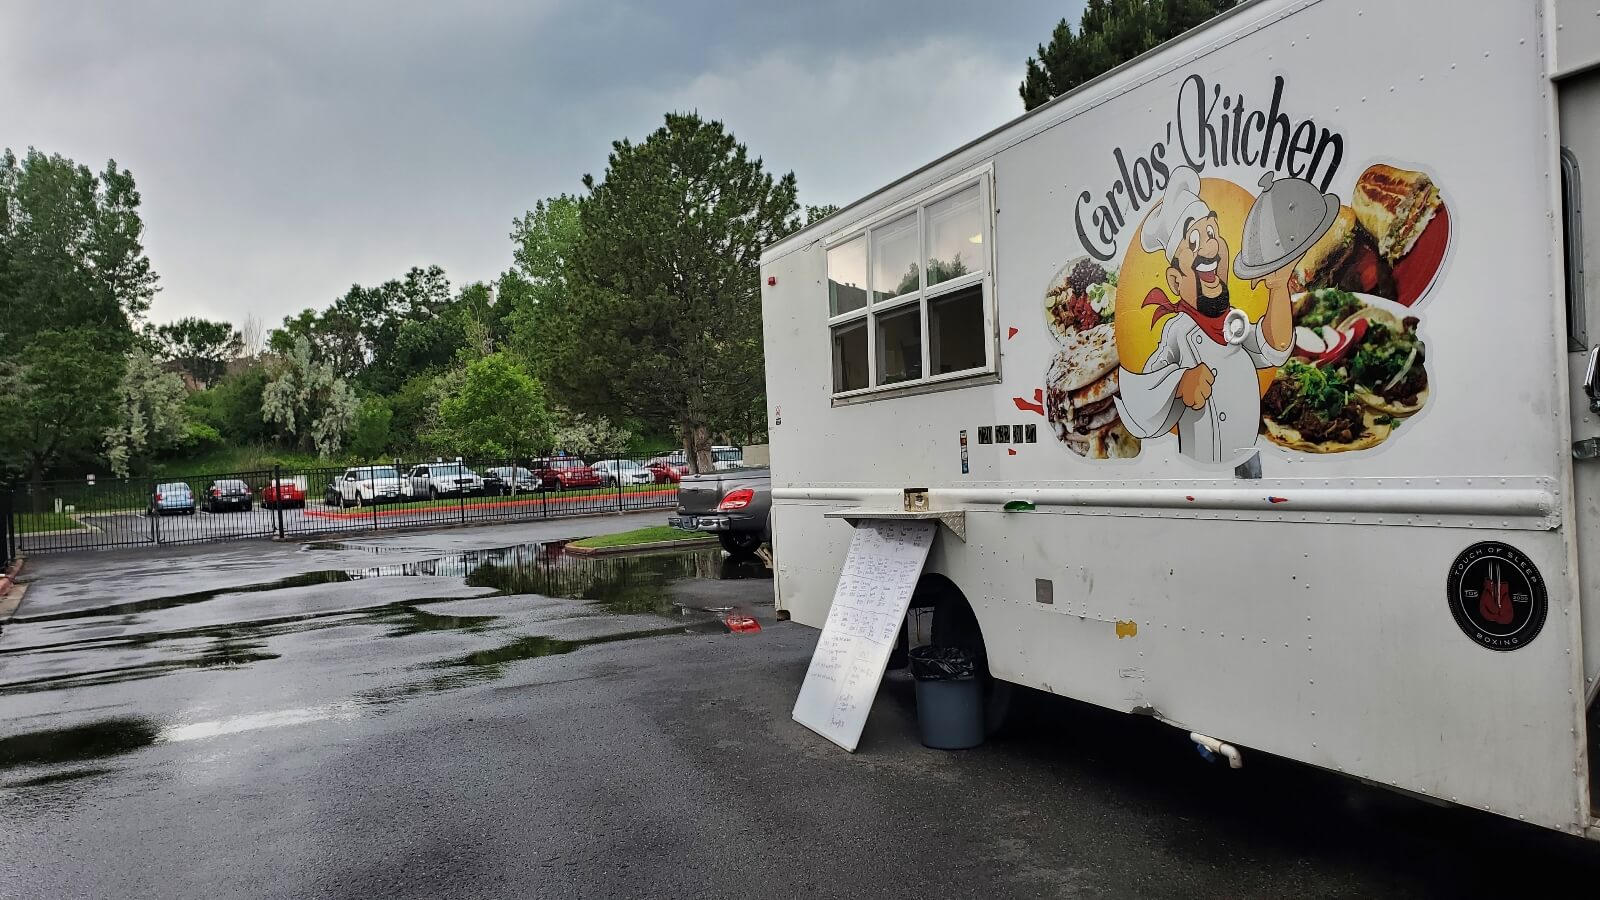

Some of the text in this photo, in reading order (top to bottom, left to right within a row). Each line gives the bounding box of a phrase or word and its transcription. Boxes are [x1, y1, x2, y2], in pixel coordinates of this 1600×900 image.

[1074, 73, 1344, 262] Carlos' Kitchen
[1454, 548, 1483, 576] TOUCH
[1507, 551, 1537, 583] SLEEP
[1476, 632, 1519, 646] BOXING
